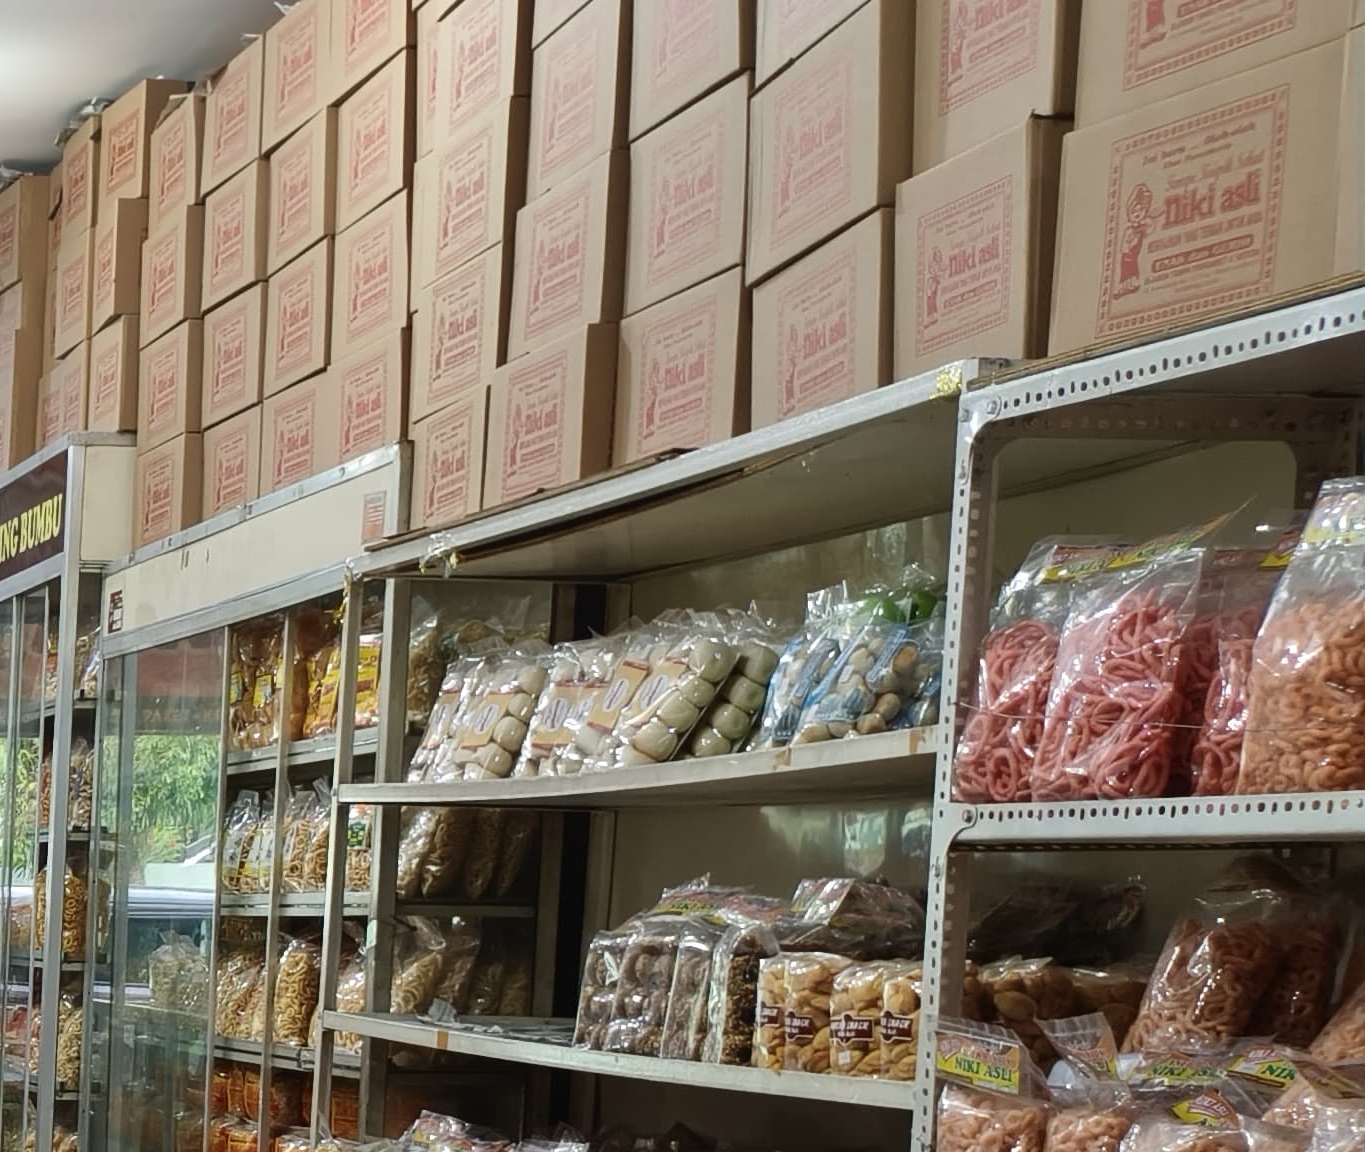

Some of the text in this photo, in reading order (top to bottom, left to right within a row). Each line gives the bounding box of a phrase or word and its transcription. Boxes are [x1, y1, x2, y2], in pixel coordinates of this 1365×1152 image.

[1161, 176, 1218, 230] niki
[1219, 169, 1263, 213] asli
[19, 493, 63, 553] BUMBU
[955, 1056, 980, 1075] NIKI
